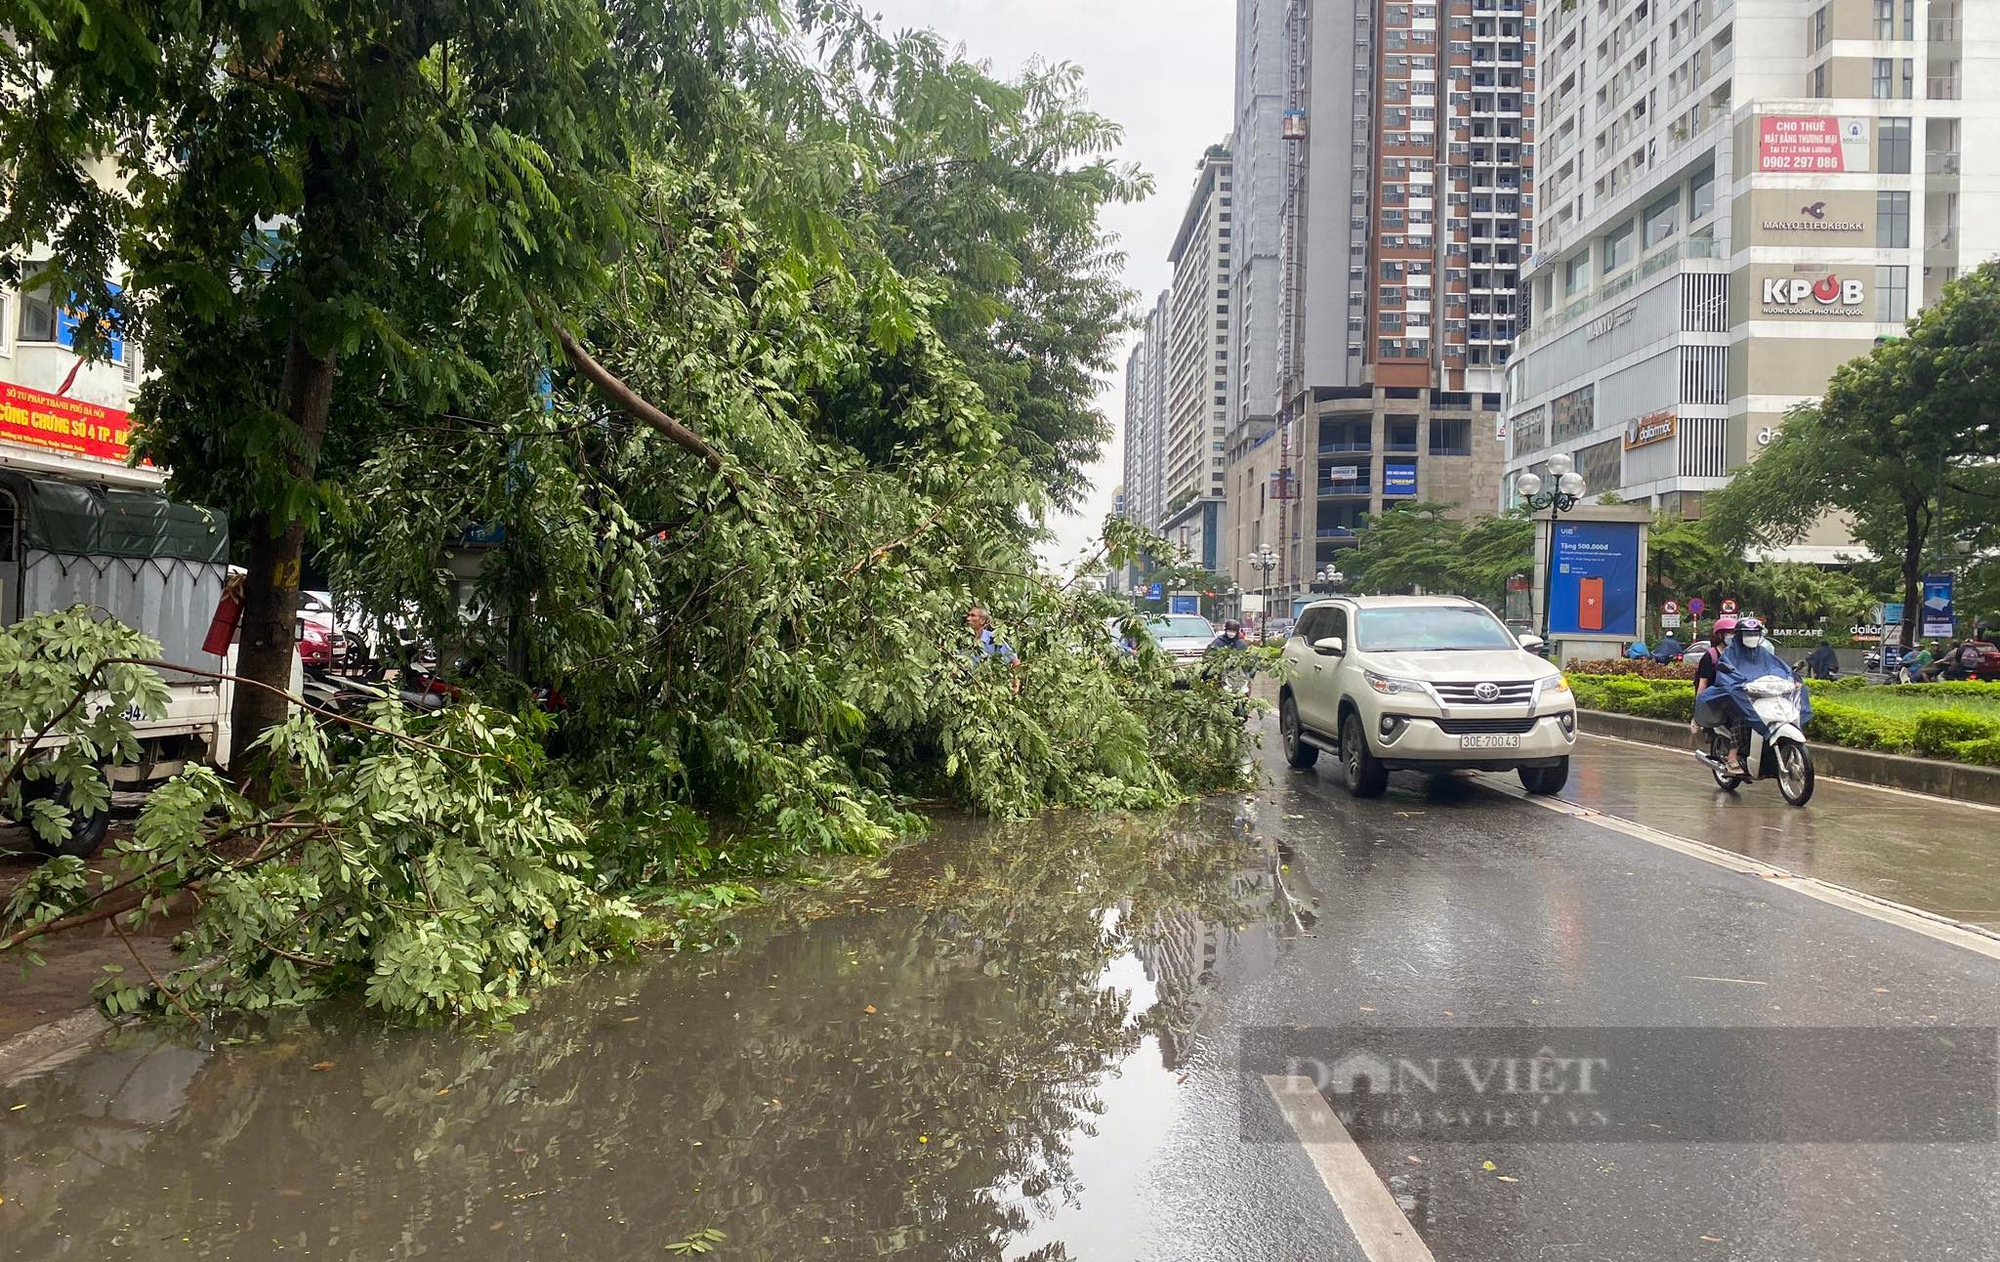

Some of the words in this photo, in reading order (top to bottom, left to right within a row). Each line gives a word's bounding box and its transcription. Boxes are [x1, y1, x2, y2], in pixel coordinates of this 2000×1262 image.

[1776, 121, 1797, 132] CHO
[1799, 120, 1826, 132] THUÊ
[1763, 156, 1791, 168] 0902
[1793, 156, 1815, 168] 297
[1817, 156, 1838, 168] 086
[1763, 221, 1800, 231] MANYO
[6, 388, 16, 398] SỞ
[69, 402, 84, 413] PHỐ
[31, 410, 70, 435] CHỨNG
[71, 417, 87, 438] SỐ
[88, 424, 95, 440] 4
[97, 425, 113, 443] TP.
[1560, 542, 1577, 551] Tặng
